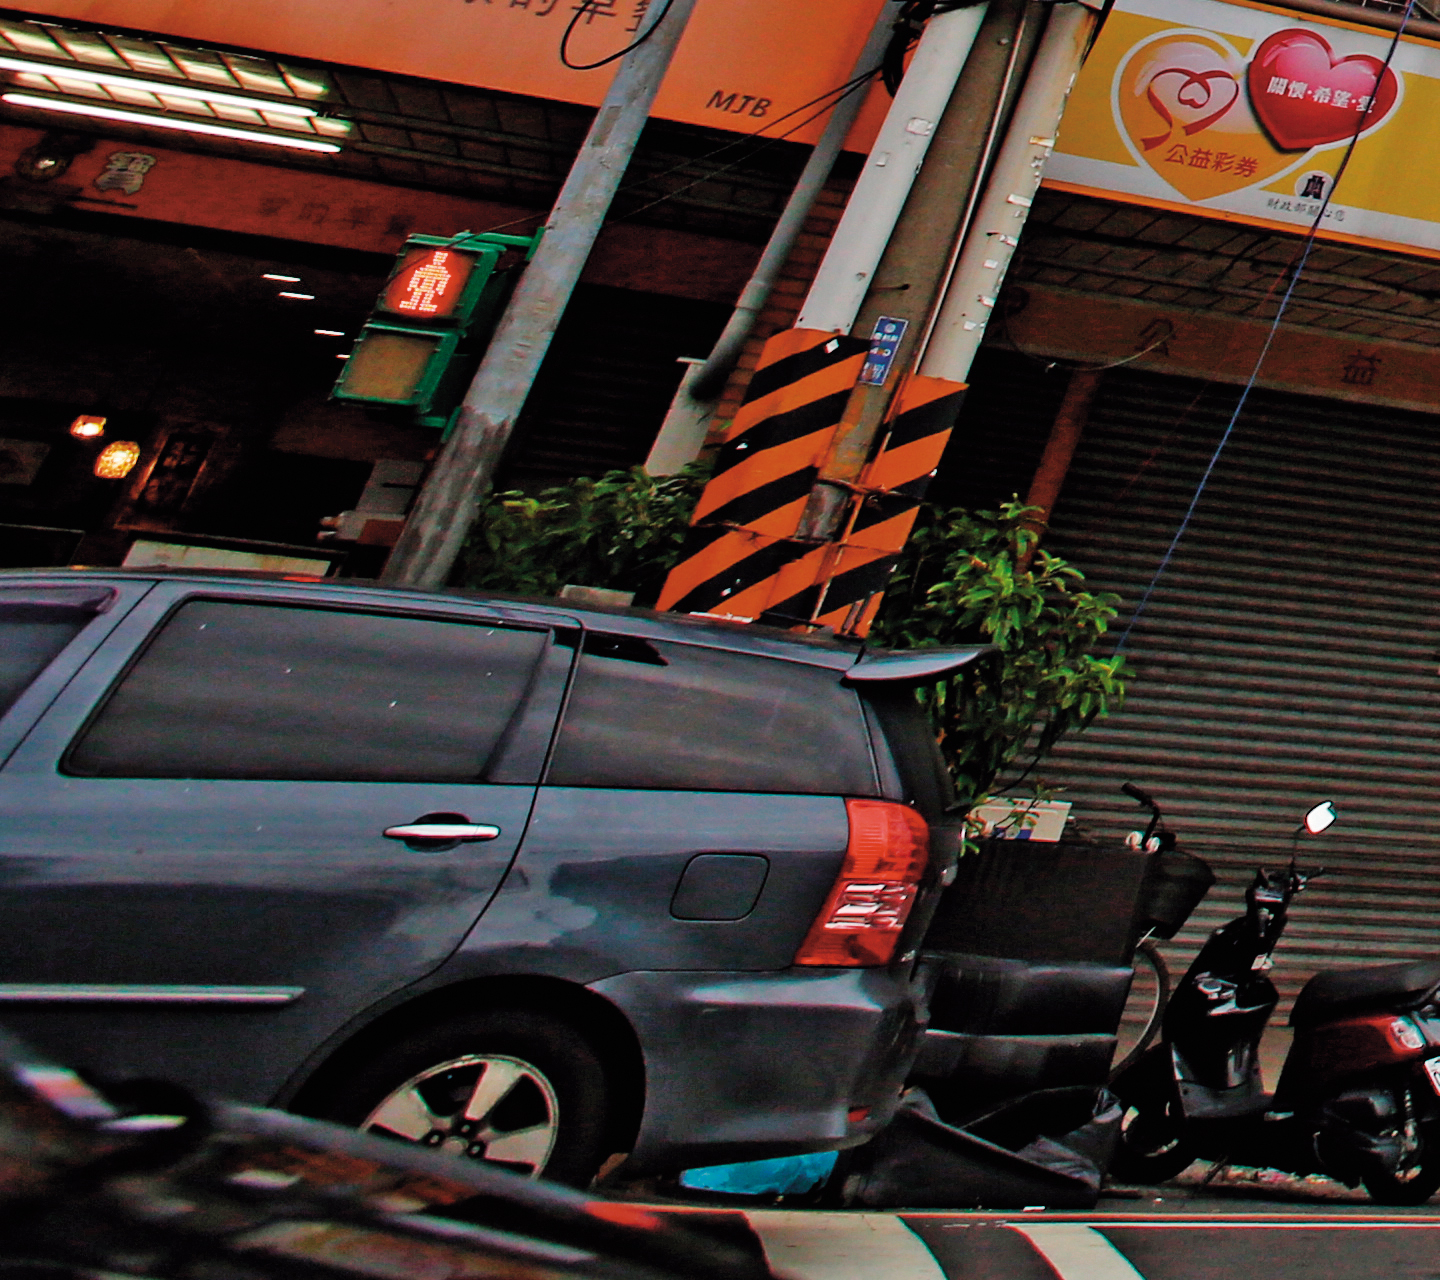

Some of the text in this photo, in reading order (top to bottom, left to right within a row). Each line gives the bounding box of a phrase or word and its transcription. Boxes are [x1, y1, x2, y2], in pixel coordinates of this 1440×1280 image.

[706, 90, 772, 118] MJB
[1165, 143, 1258, 178] 公益彩券
